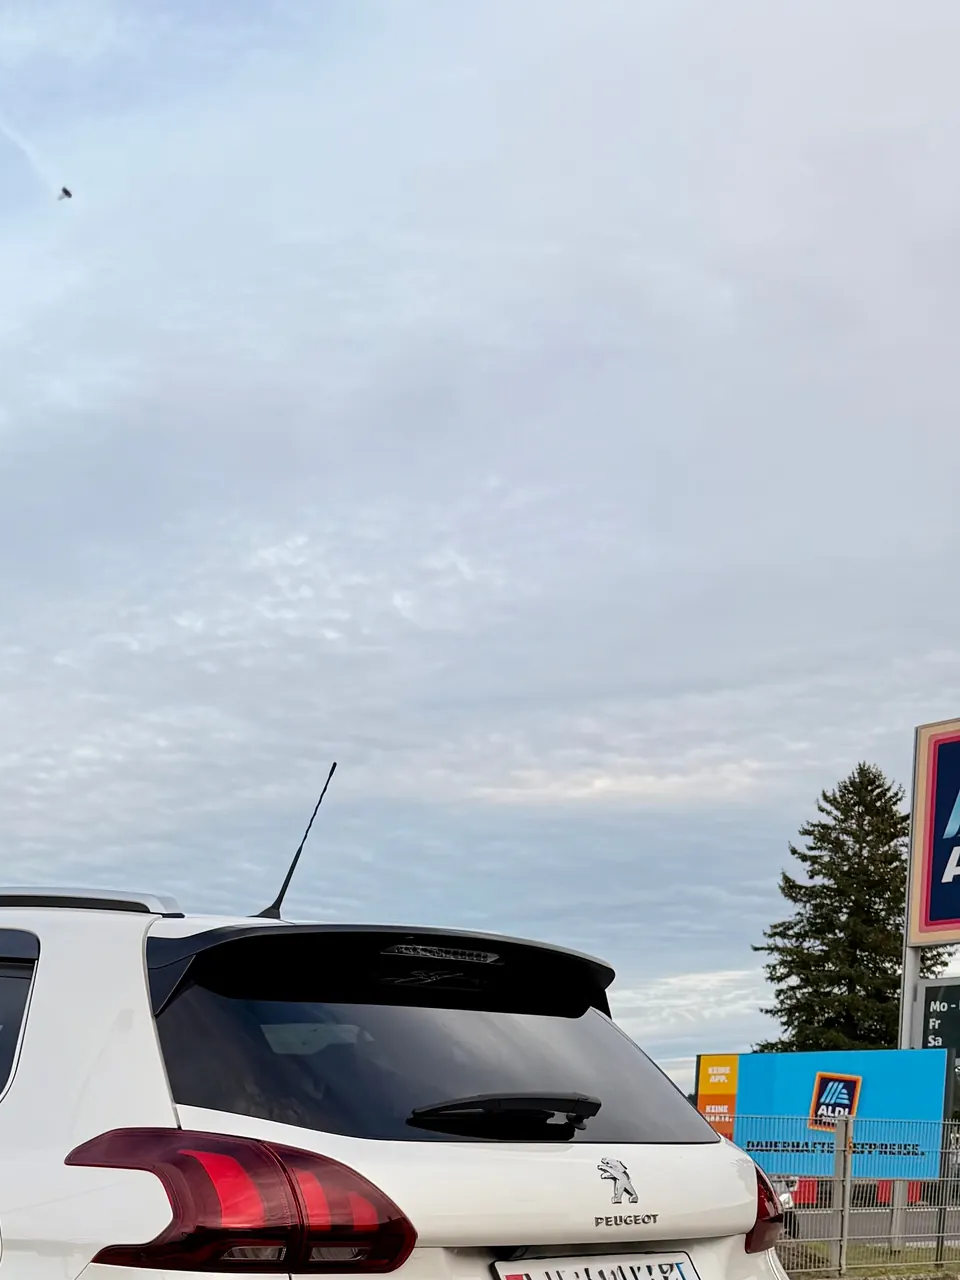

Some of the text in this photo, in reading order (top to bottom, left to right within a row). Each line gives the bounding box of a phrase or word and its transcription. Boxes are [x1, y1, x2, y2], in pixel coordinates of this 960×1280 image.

[930, 1001, 948, 1012] Mo
[929, 1018, 941, 1030] Fr
[927, 1035, 943, 1047] Sa
[817, 1104, 849, 1117] ALDI
[594, 1213, 659, 1227] PEUGEOT
